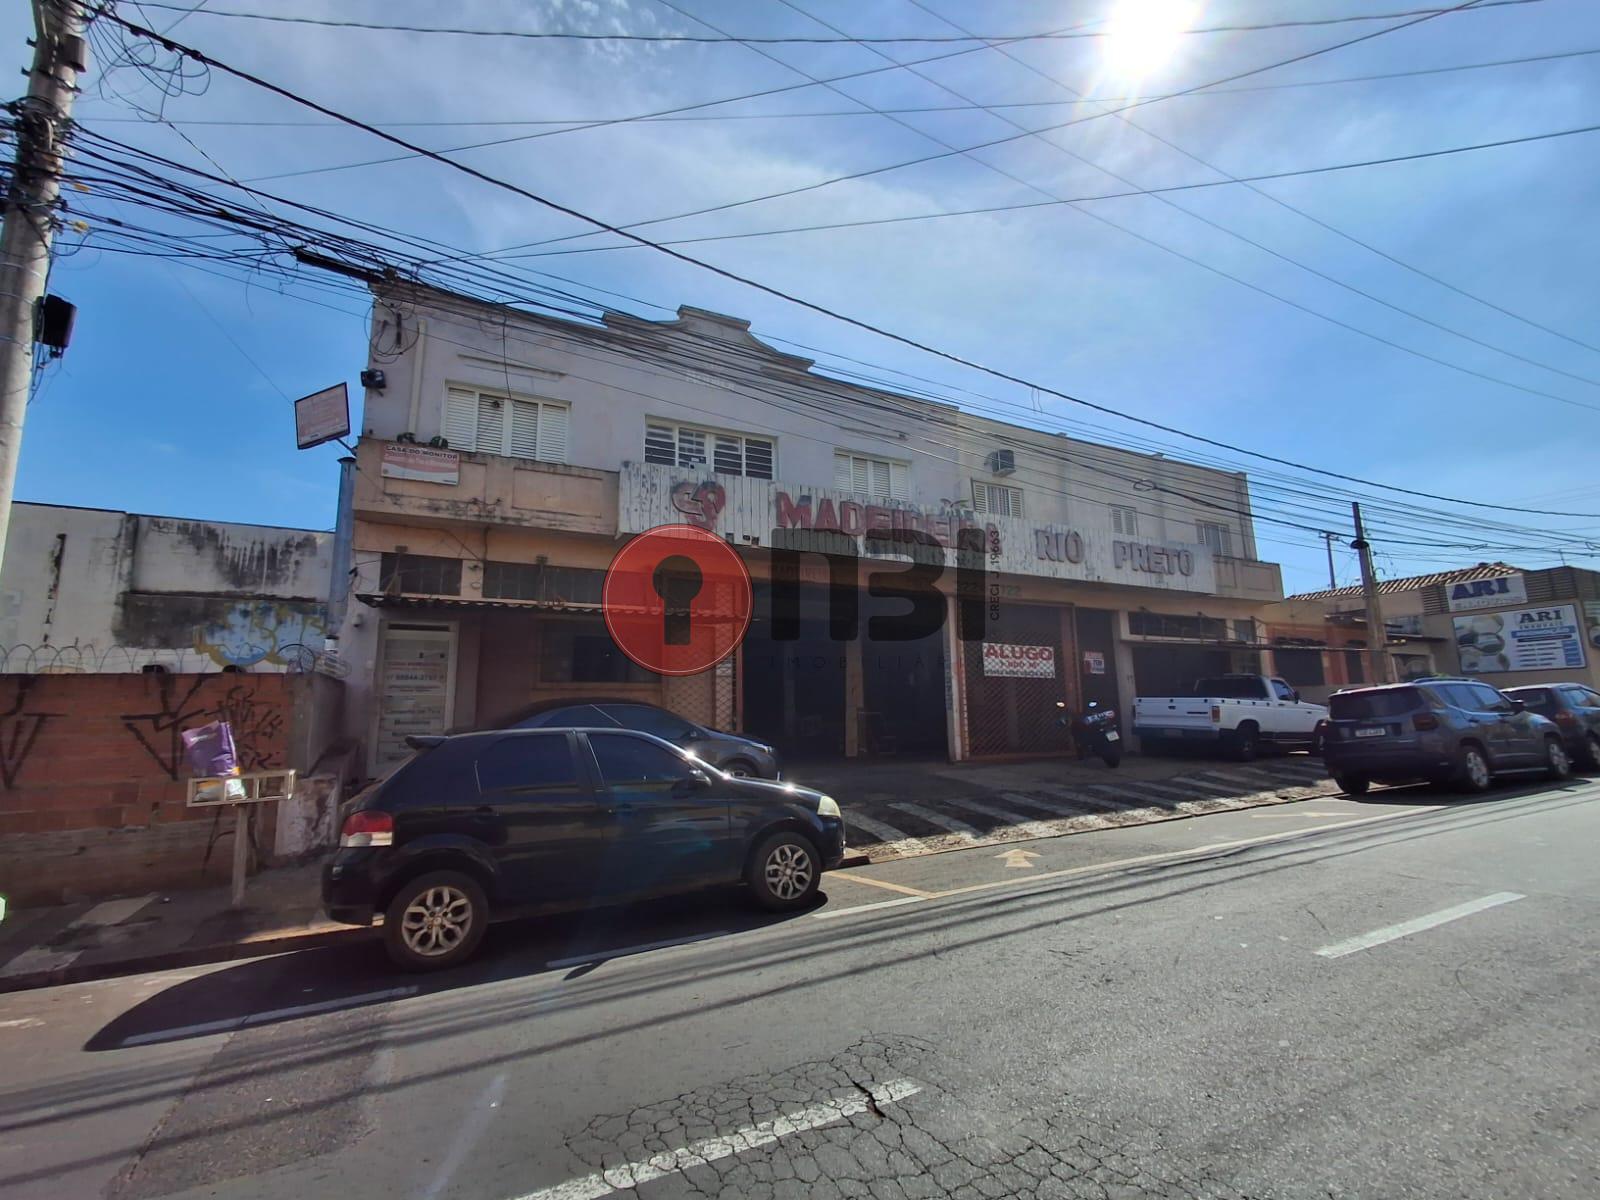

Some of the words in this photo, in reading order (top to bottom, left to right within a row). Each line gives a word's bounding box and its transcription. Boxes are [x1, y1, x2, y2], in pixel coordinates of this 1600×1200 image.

[386, 445, 407, 453] CASA
[422, 451, 458, 459] MONITOR
[776, 491, 1003, 554] MADEIREIRA
[1112, 539, 1195, 577] PRETO
[1452, 578, 1510, 600] ARI
[1519, 610, 1562, 624] ARI
[984, 644, 1053, 661] ALUGO
